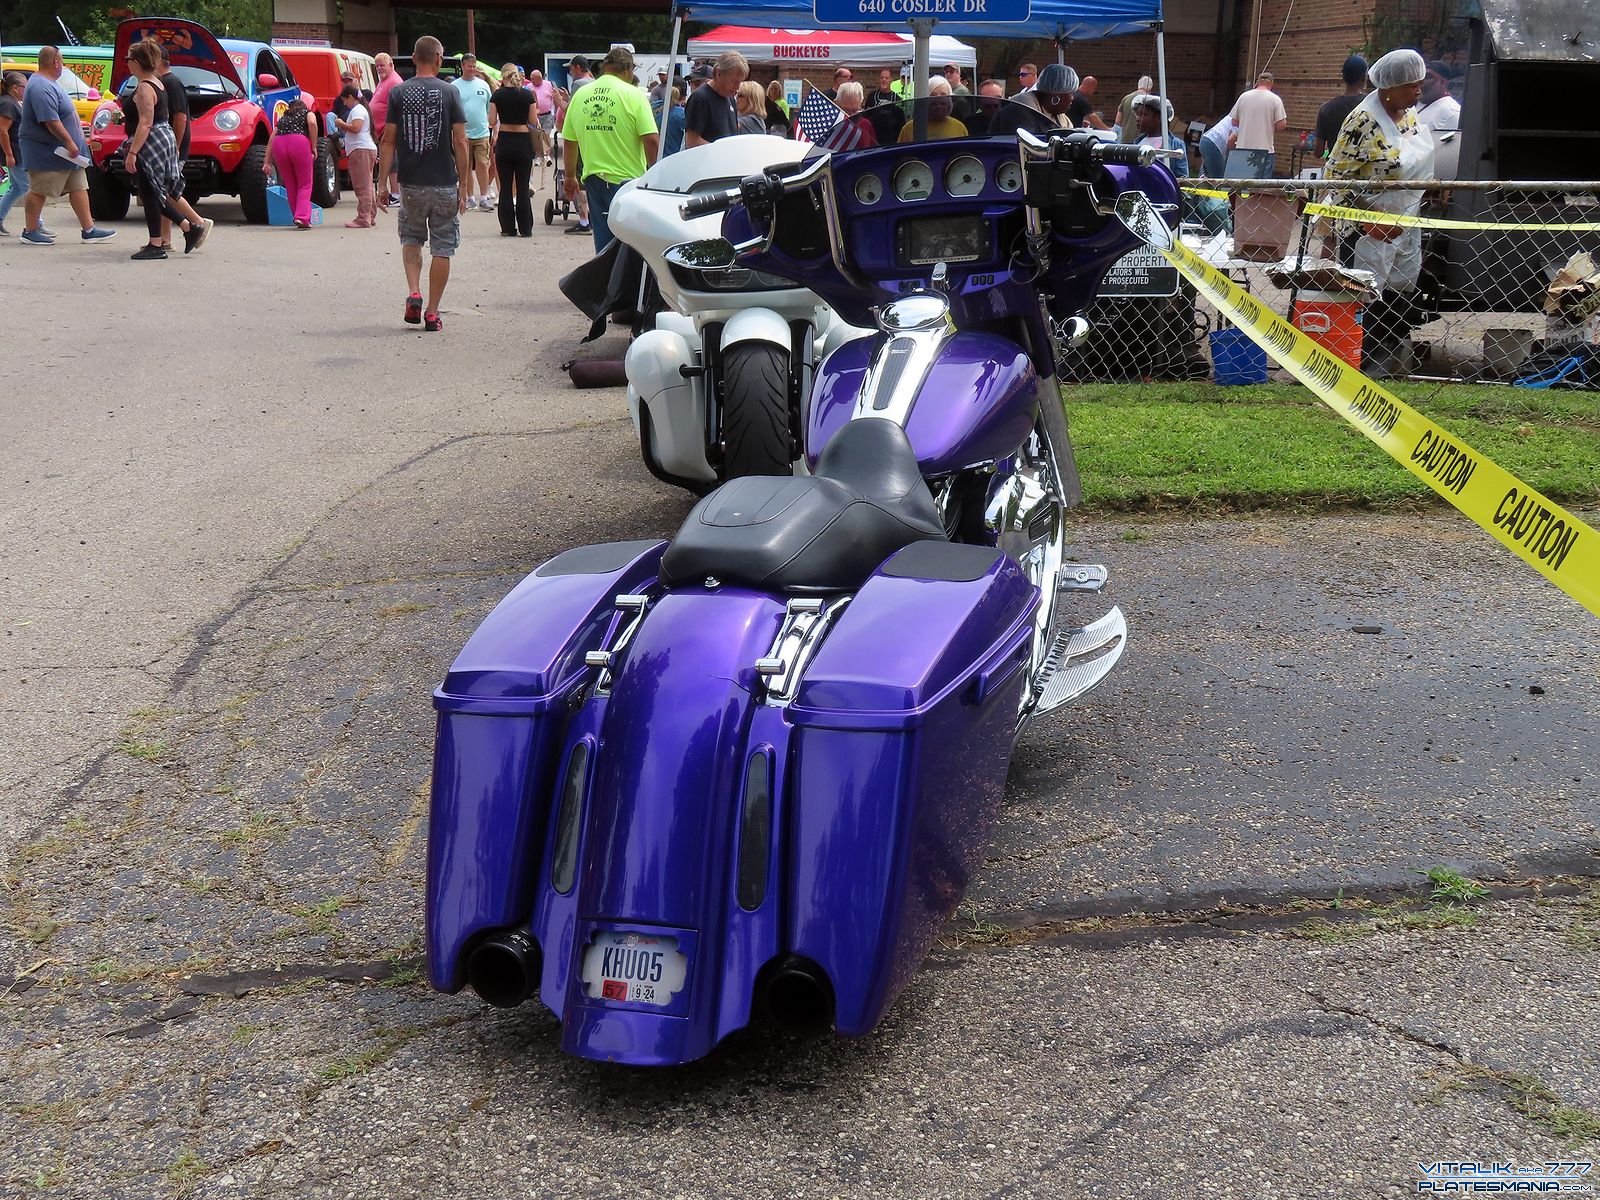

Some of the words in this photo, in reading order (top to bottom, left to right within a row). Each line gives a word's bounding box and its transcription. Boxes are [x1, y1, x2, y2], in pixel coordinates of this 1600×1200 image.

[858, 0, 886, 13] 640
[891, 0, 957, 13] COSLER
[963, 0, 987, 13] DR
[773, 45, 830, 58] BUCKEYES
[594, 87, 611, 95] STAFF
[583, 95, 616, 107] WOODY'S
[1122, 256, 1167, 266] PROPERTY
[1106, 268, 1132, 276] LATORS
[1135, 268, 1149, 276] WILL
[1108, 277, 1149, 285] PROSECUTED
[1206, 275, 1232, 302] CAUTION
[1231, 295, 1262, 327] CAUTION
[1262, 320, 1298, 357] CAUTION
[1300, 349, 1344, 394] CAUTION
[1348, 385, 1401, 438] CAUTION
[1410, 430, 1478, 495] CAUTION
[1492, 488, 1580, 571] CAUTION
[601, 947, 663, 982] KHU05
[604, 984, 625, 998] 57
